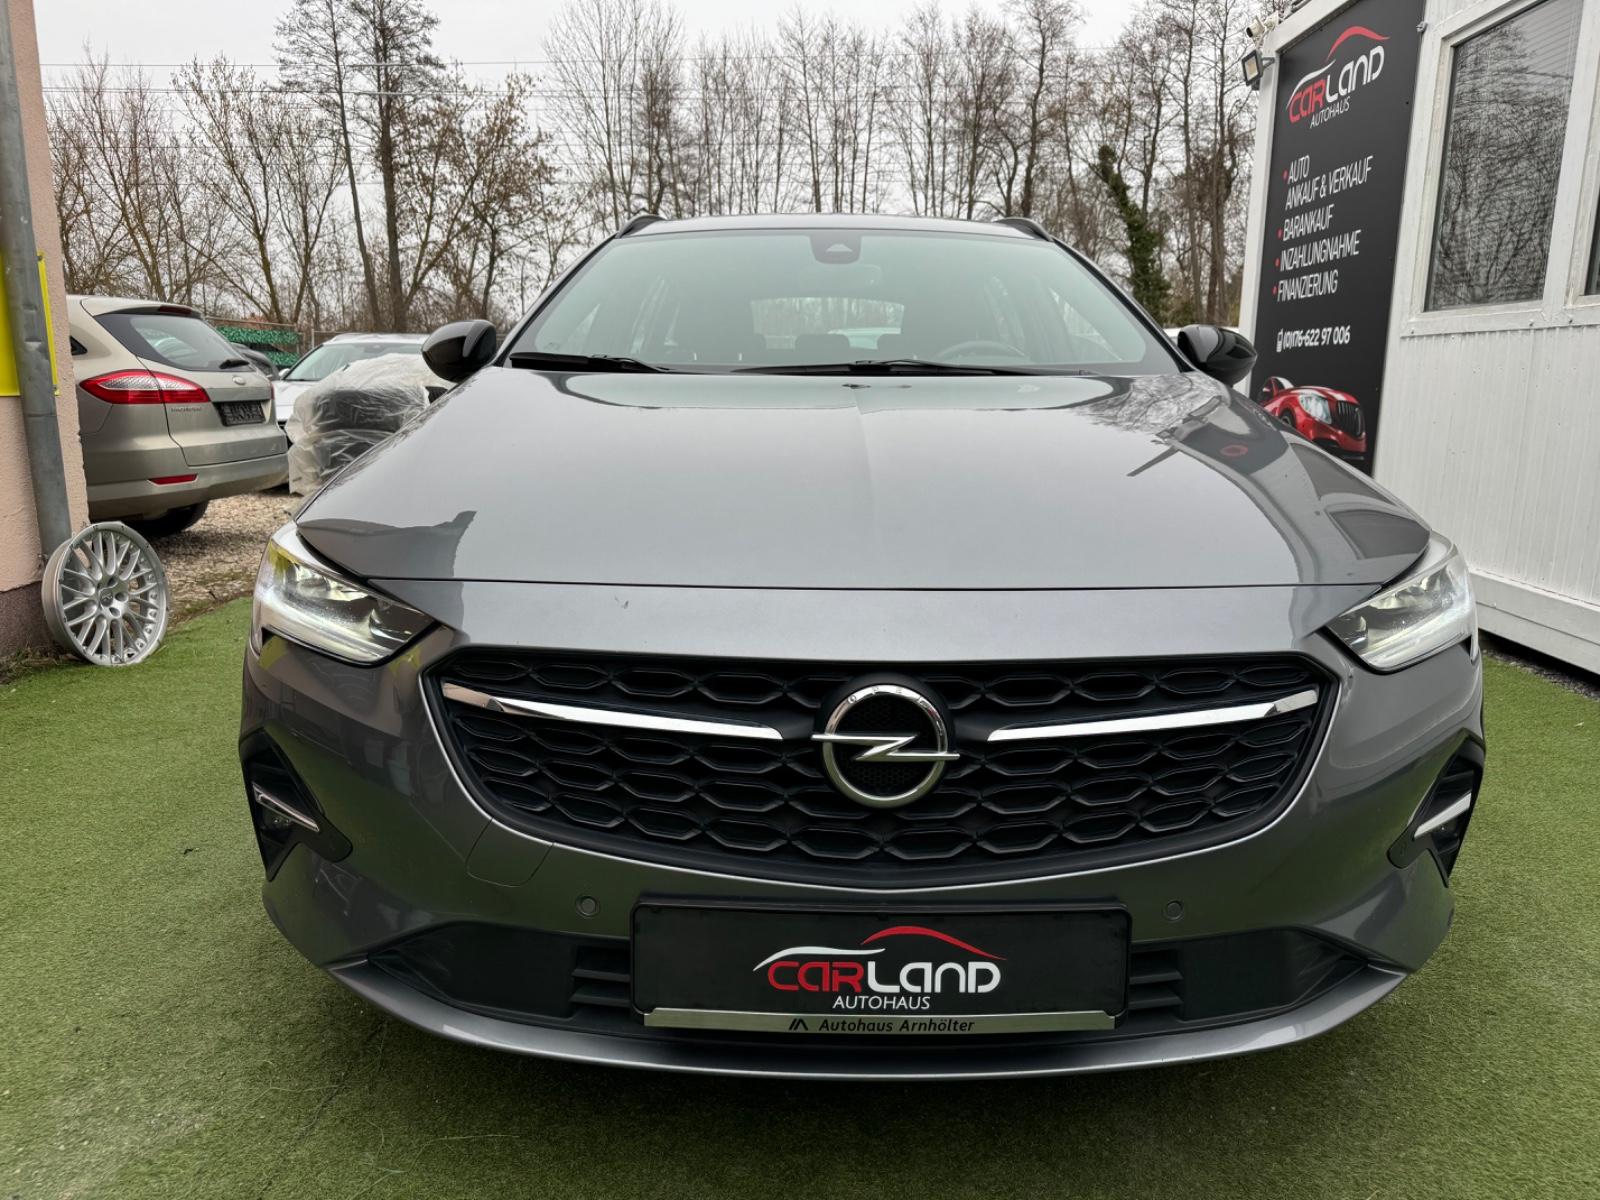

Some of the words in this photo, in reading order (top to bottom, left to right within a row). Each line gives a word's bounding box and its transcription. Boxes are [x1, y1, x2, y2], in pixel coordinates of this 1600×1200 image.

[1309, 96, 1351, 128] AUTOHAUS
[1285, 176, 1320, 211] ANKAUF
[1320, 174, 1326, 198] &
[1329, 155, 1374, 195] VERKAUF
[1287, 155, 1311, 185] AUTO
[1282, 204, 1335, 241] BARANKAUF
[1280, 229, 1362, 272] INZAHLUNGNAHME
[1277, 270, 1339, 302] FINANZIERUNG
[1321, 327, 1333, 346] 97
[1333, 325, 1351, 345] 006
[832, 995, 931, 1010] AUTOHAUS
[818, 1019, 894, 1033] Autohaus
[898, 1018, 975, 1033] Arnhölter
